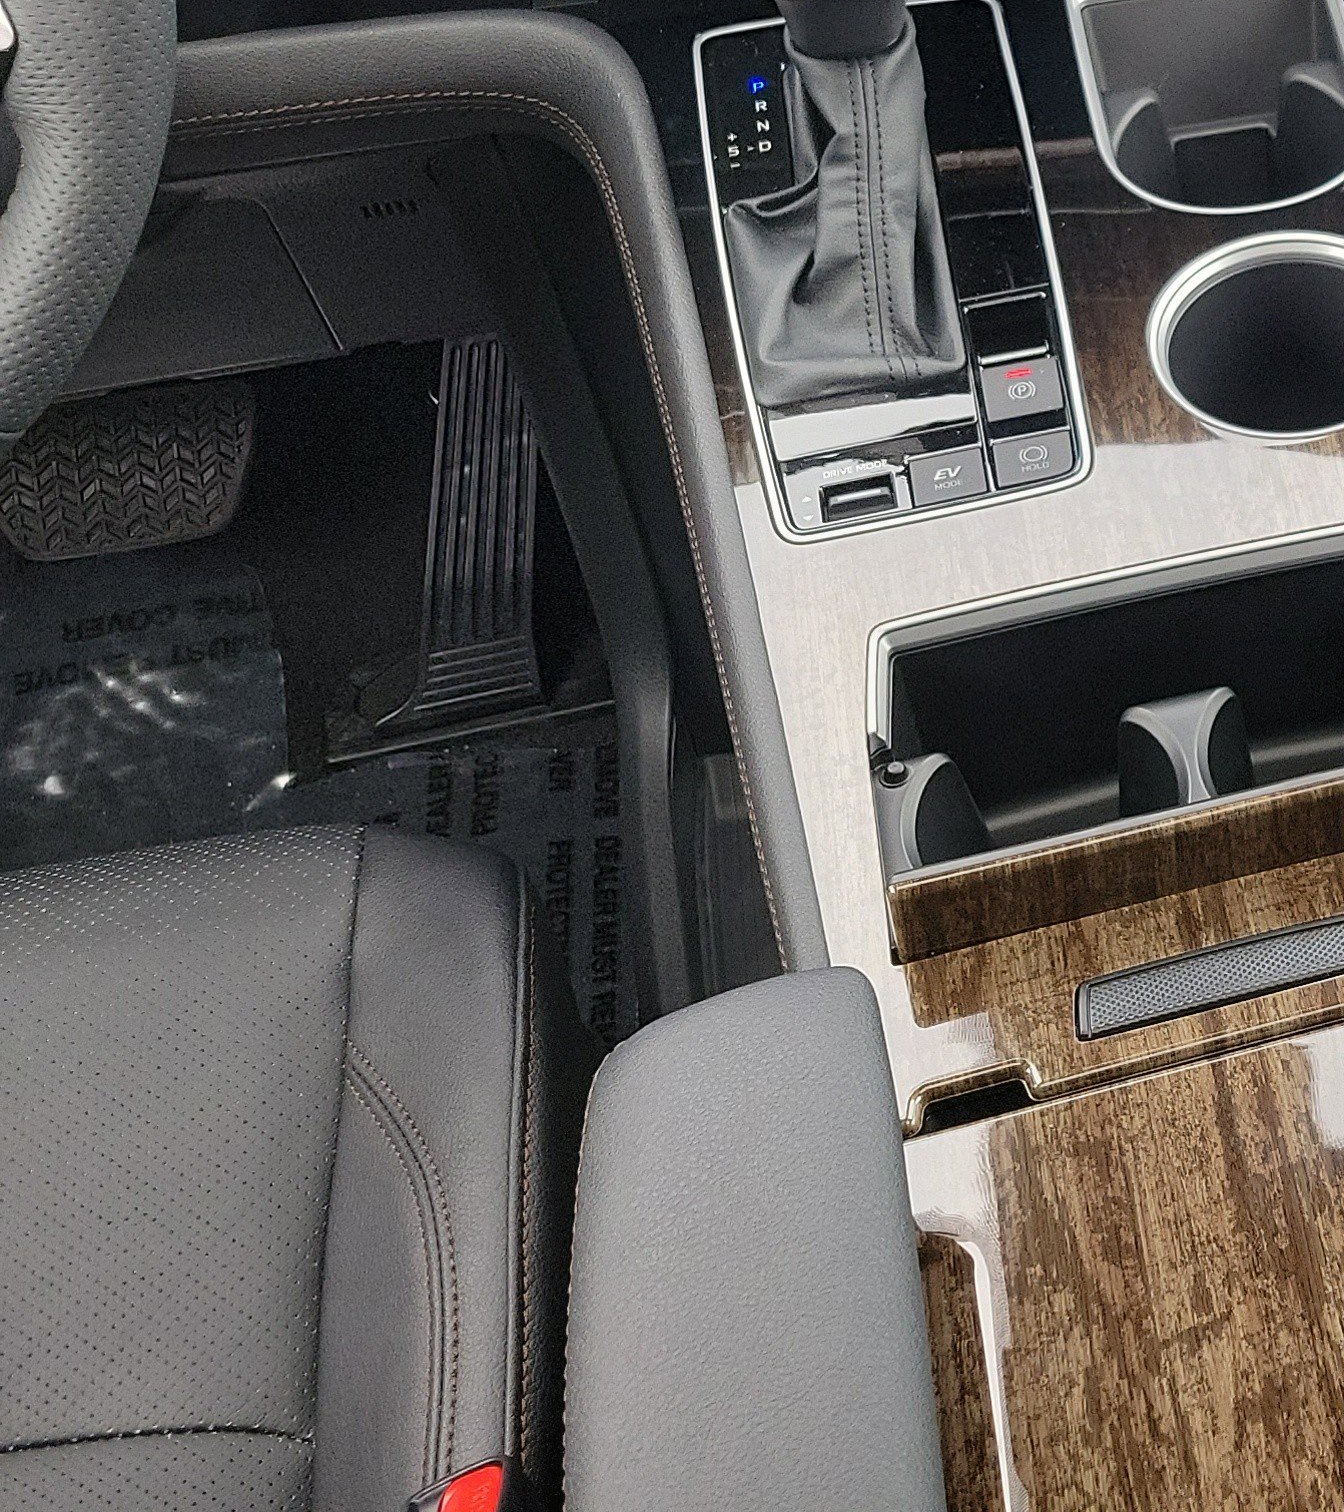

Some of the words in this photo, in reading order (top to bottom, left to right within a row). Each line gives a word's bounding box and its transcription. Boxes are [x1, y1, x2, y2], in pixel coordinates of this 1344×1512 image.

[753, 82, 764, 93] P
[755, 100, 768, 112] R
[757, 119, 770, 132] N
[728, 146, 739, 157] S
[759, 140, 772, 153] D
[933, 465, 962, 481] EV
[1022, 462, 1049, 473] HOLD
[935, 479, 961, 490] MODE
[61, 604, 176, 644] COVER
[593, 836, 621, 915] DEALER
[592, 922, 619, 986] MUST
